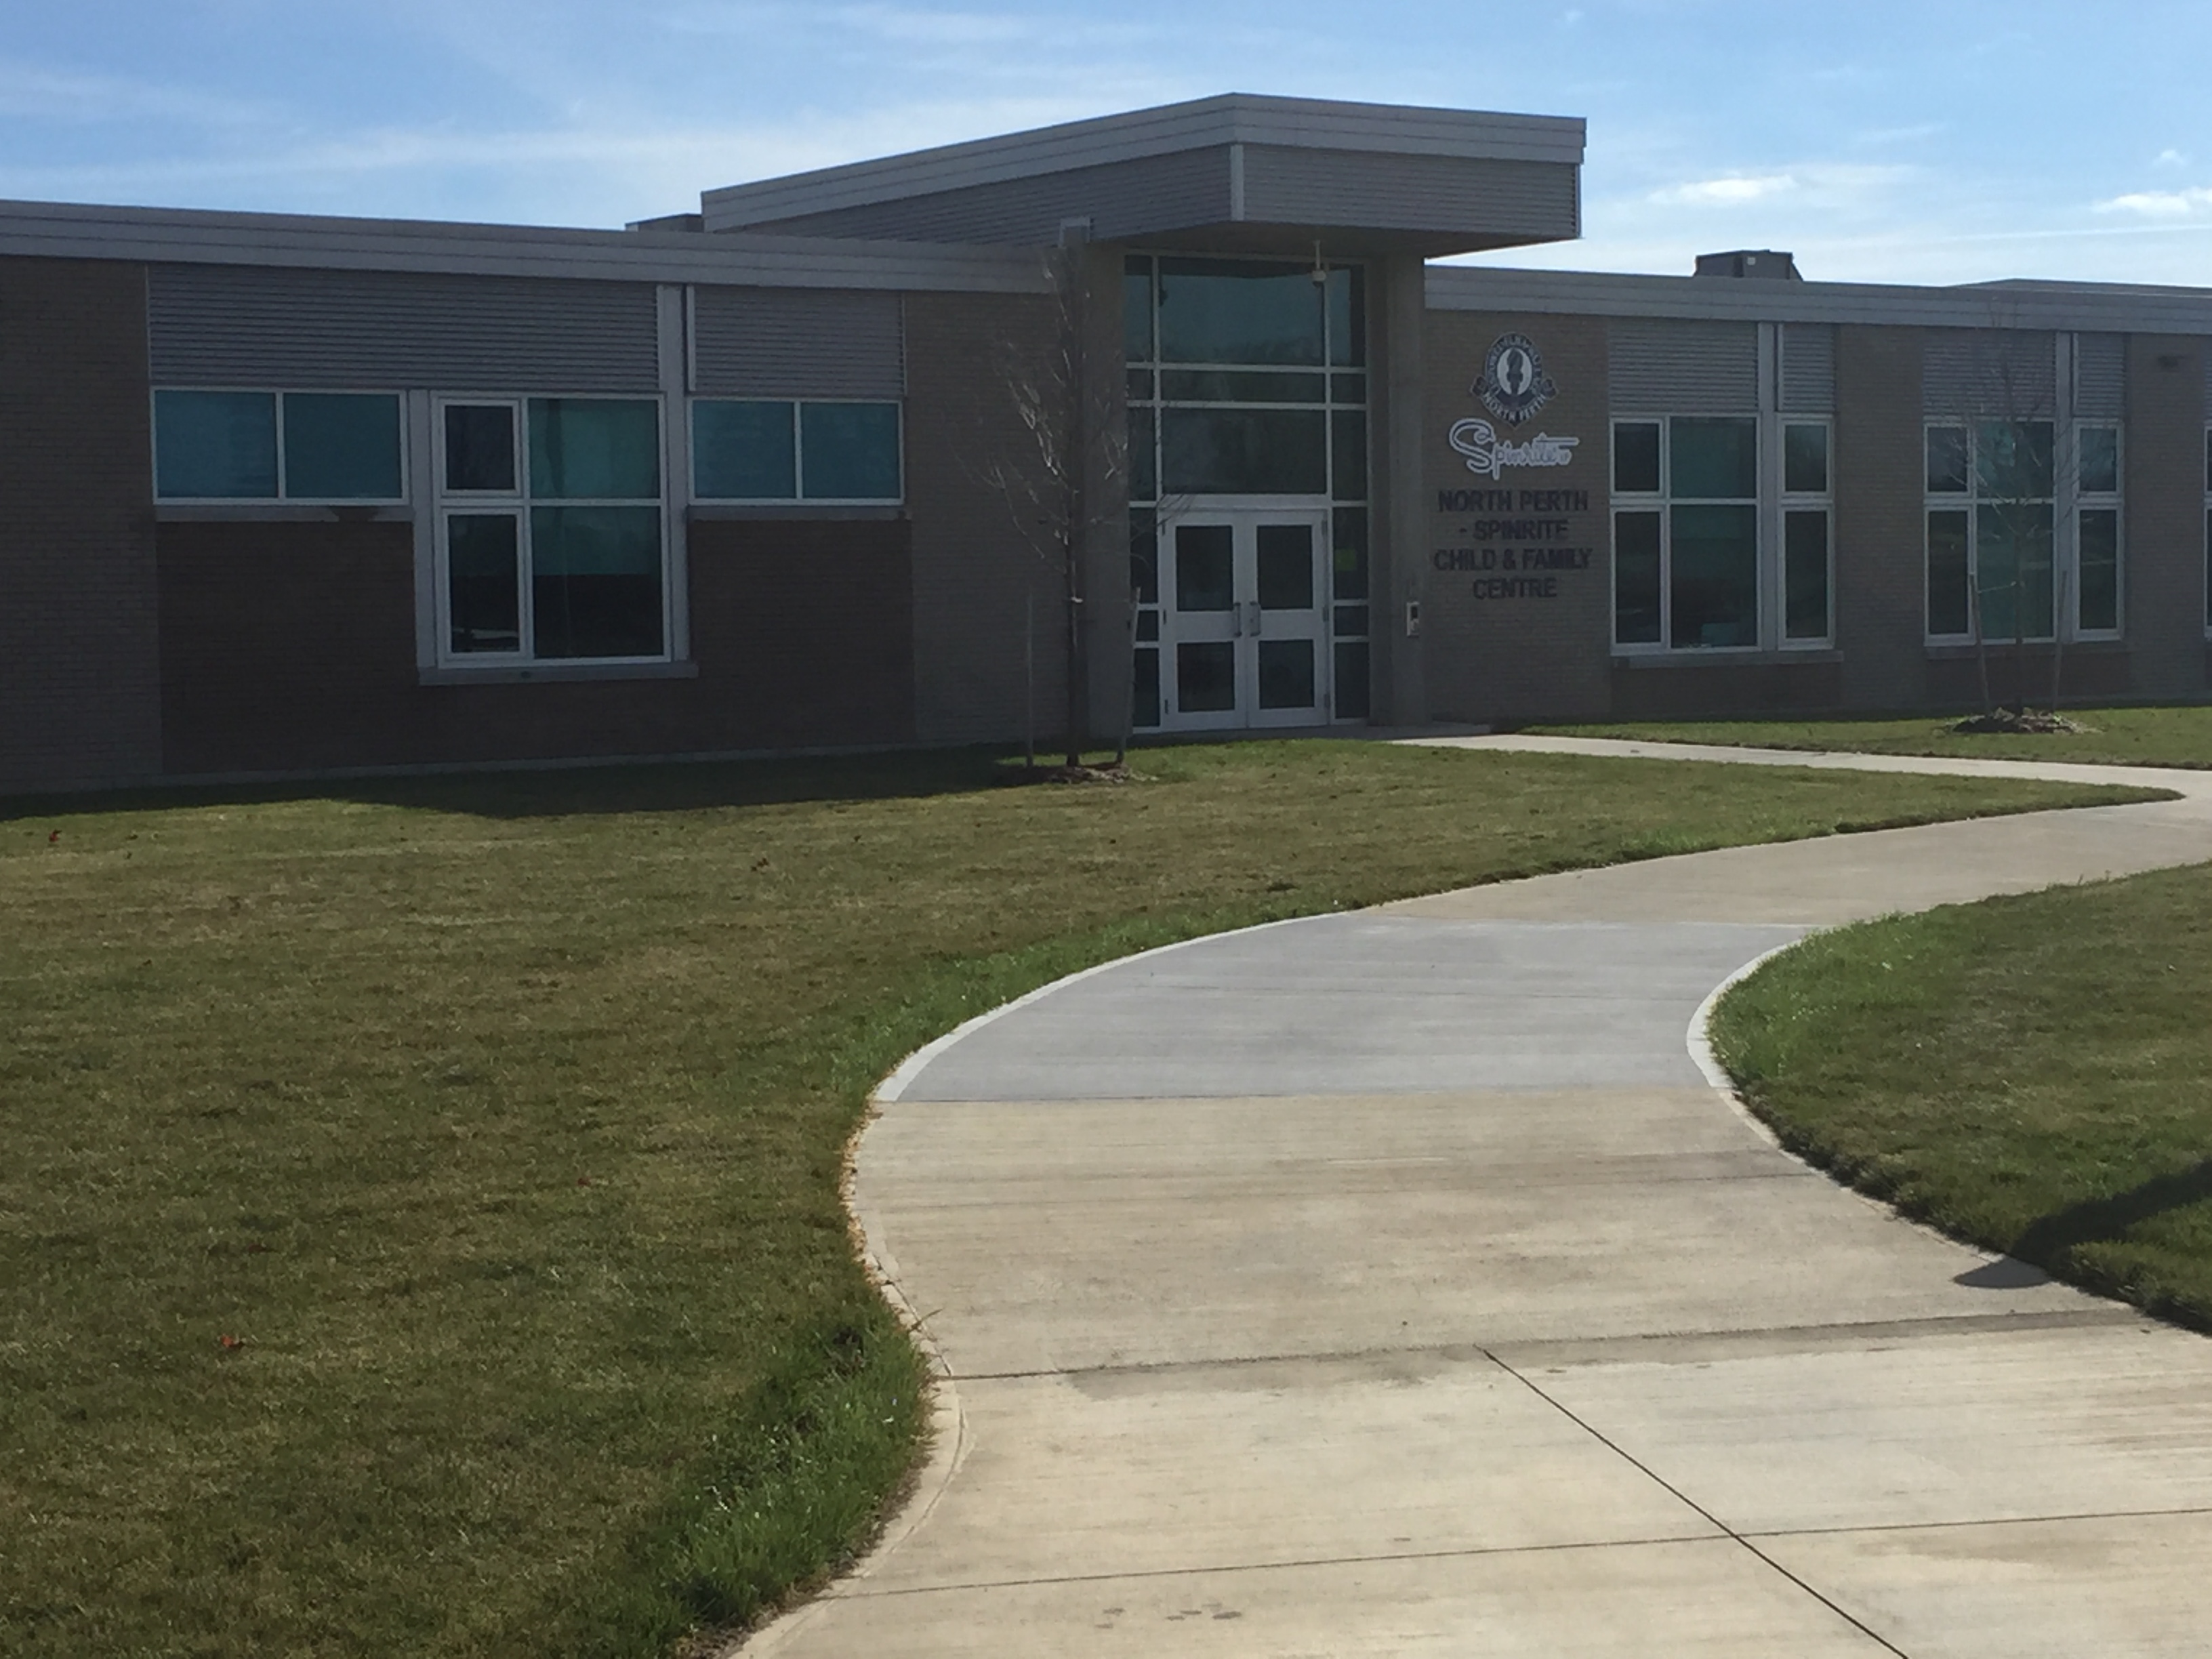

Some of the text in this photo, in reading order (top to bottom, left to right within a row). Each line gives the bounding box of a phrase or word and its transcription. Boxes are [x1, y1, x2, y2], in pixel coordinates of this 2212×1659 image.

[1482, 392, 1516, 421] NORTH
[1439, 489, 1589, 512] NORTH PERTH
[1473, 519, 1569, 540] SPINRITE
[1434, 548, 1593, 571] CHILD & FAMILY
[1473, 577, 1557, 600] CENTRE
